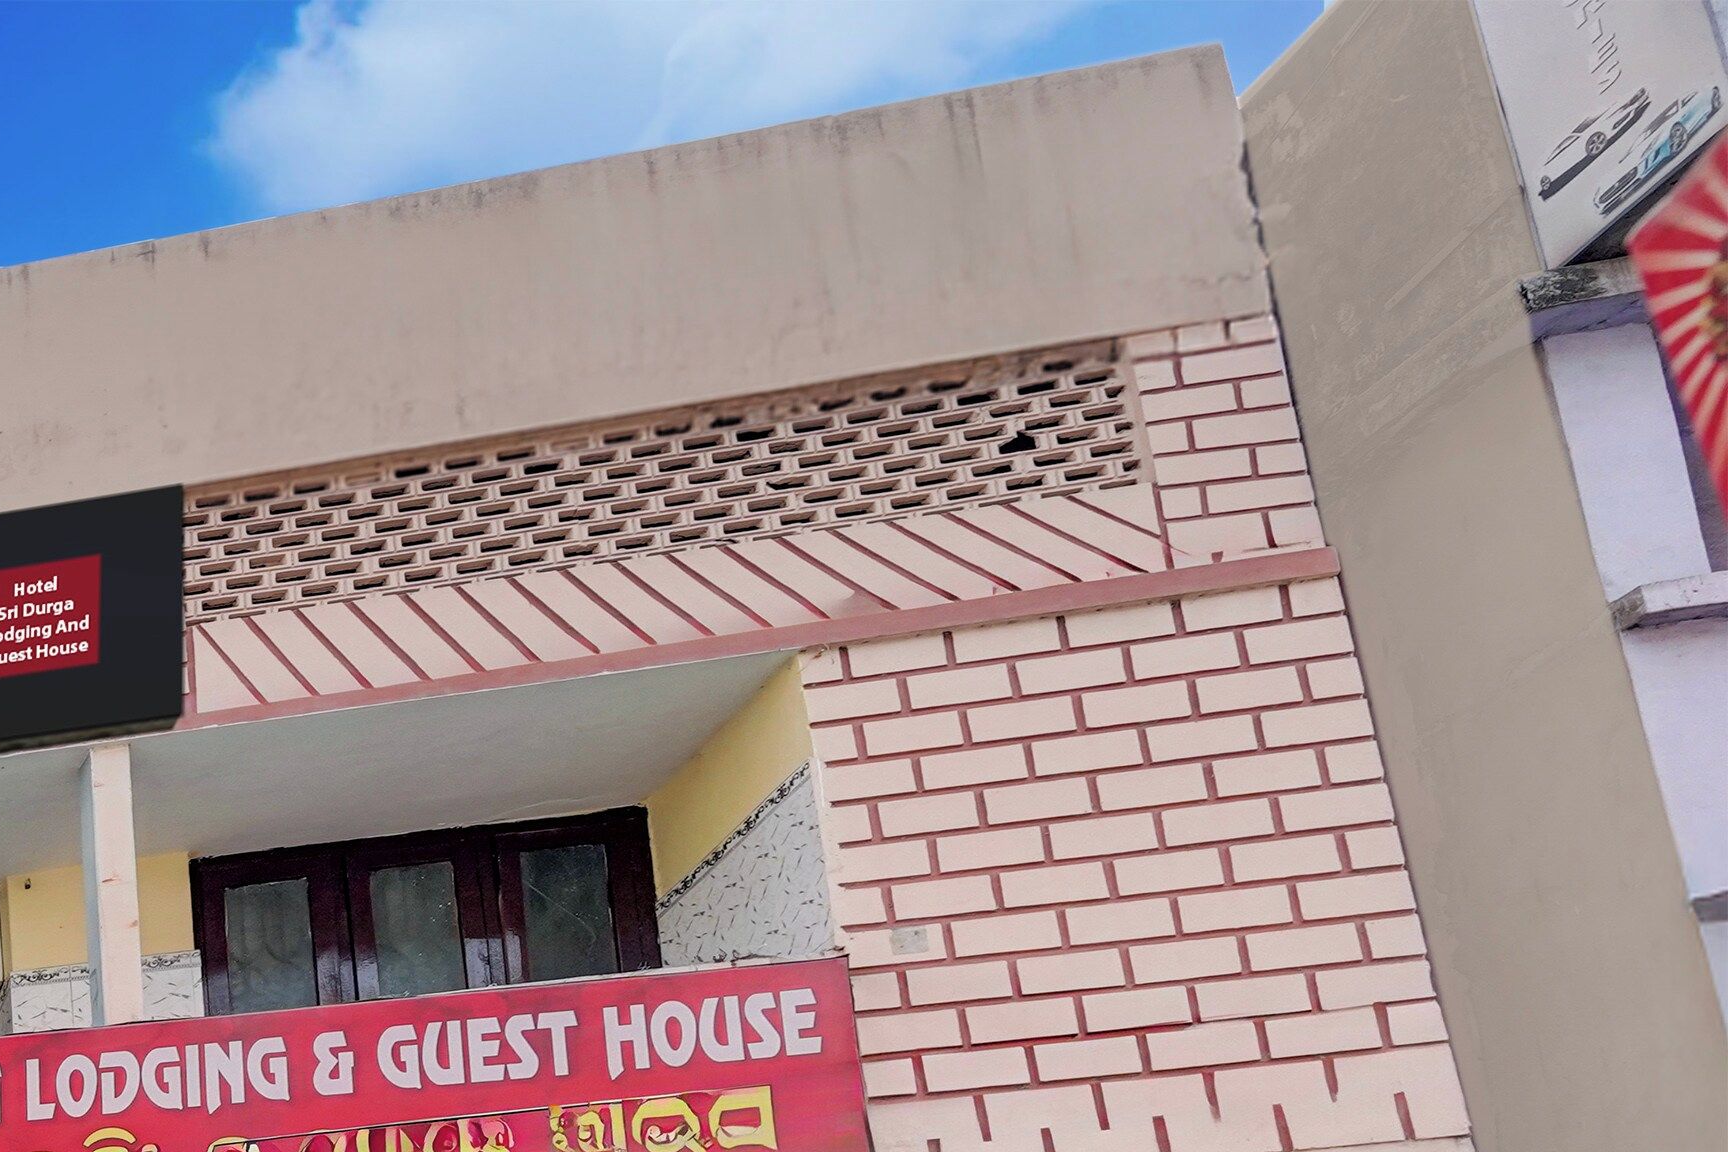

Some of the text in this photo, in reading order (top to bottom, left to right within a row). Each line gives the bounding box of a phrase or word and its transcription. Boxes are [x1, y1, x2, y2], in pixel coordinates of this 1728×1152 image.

[14, 576, 58, 597] Hotel
[23, 599, 74, 617] Durga
[55, 614, 90, 634] And
[36, 641, 89, 659] House
[26, 1035, 290, 1122] LODGING
[313, 1031, 355, 1096] &
[377, 1010, 578, 1090] GUEST
[604, 988, 824, 1081] HOUSE
